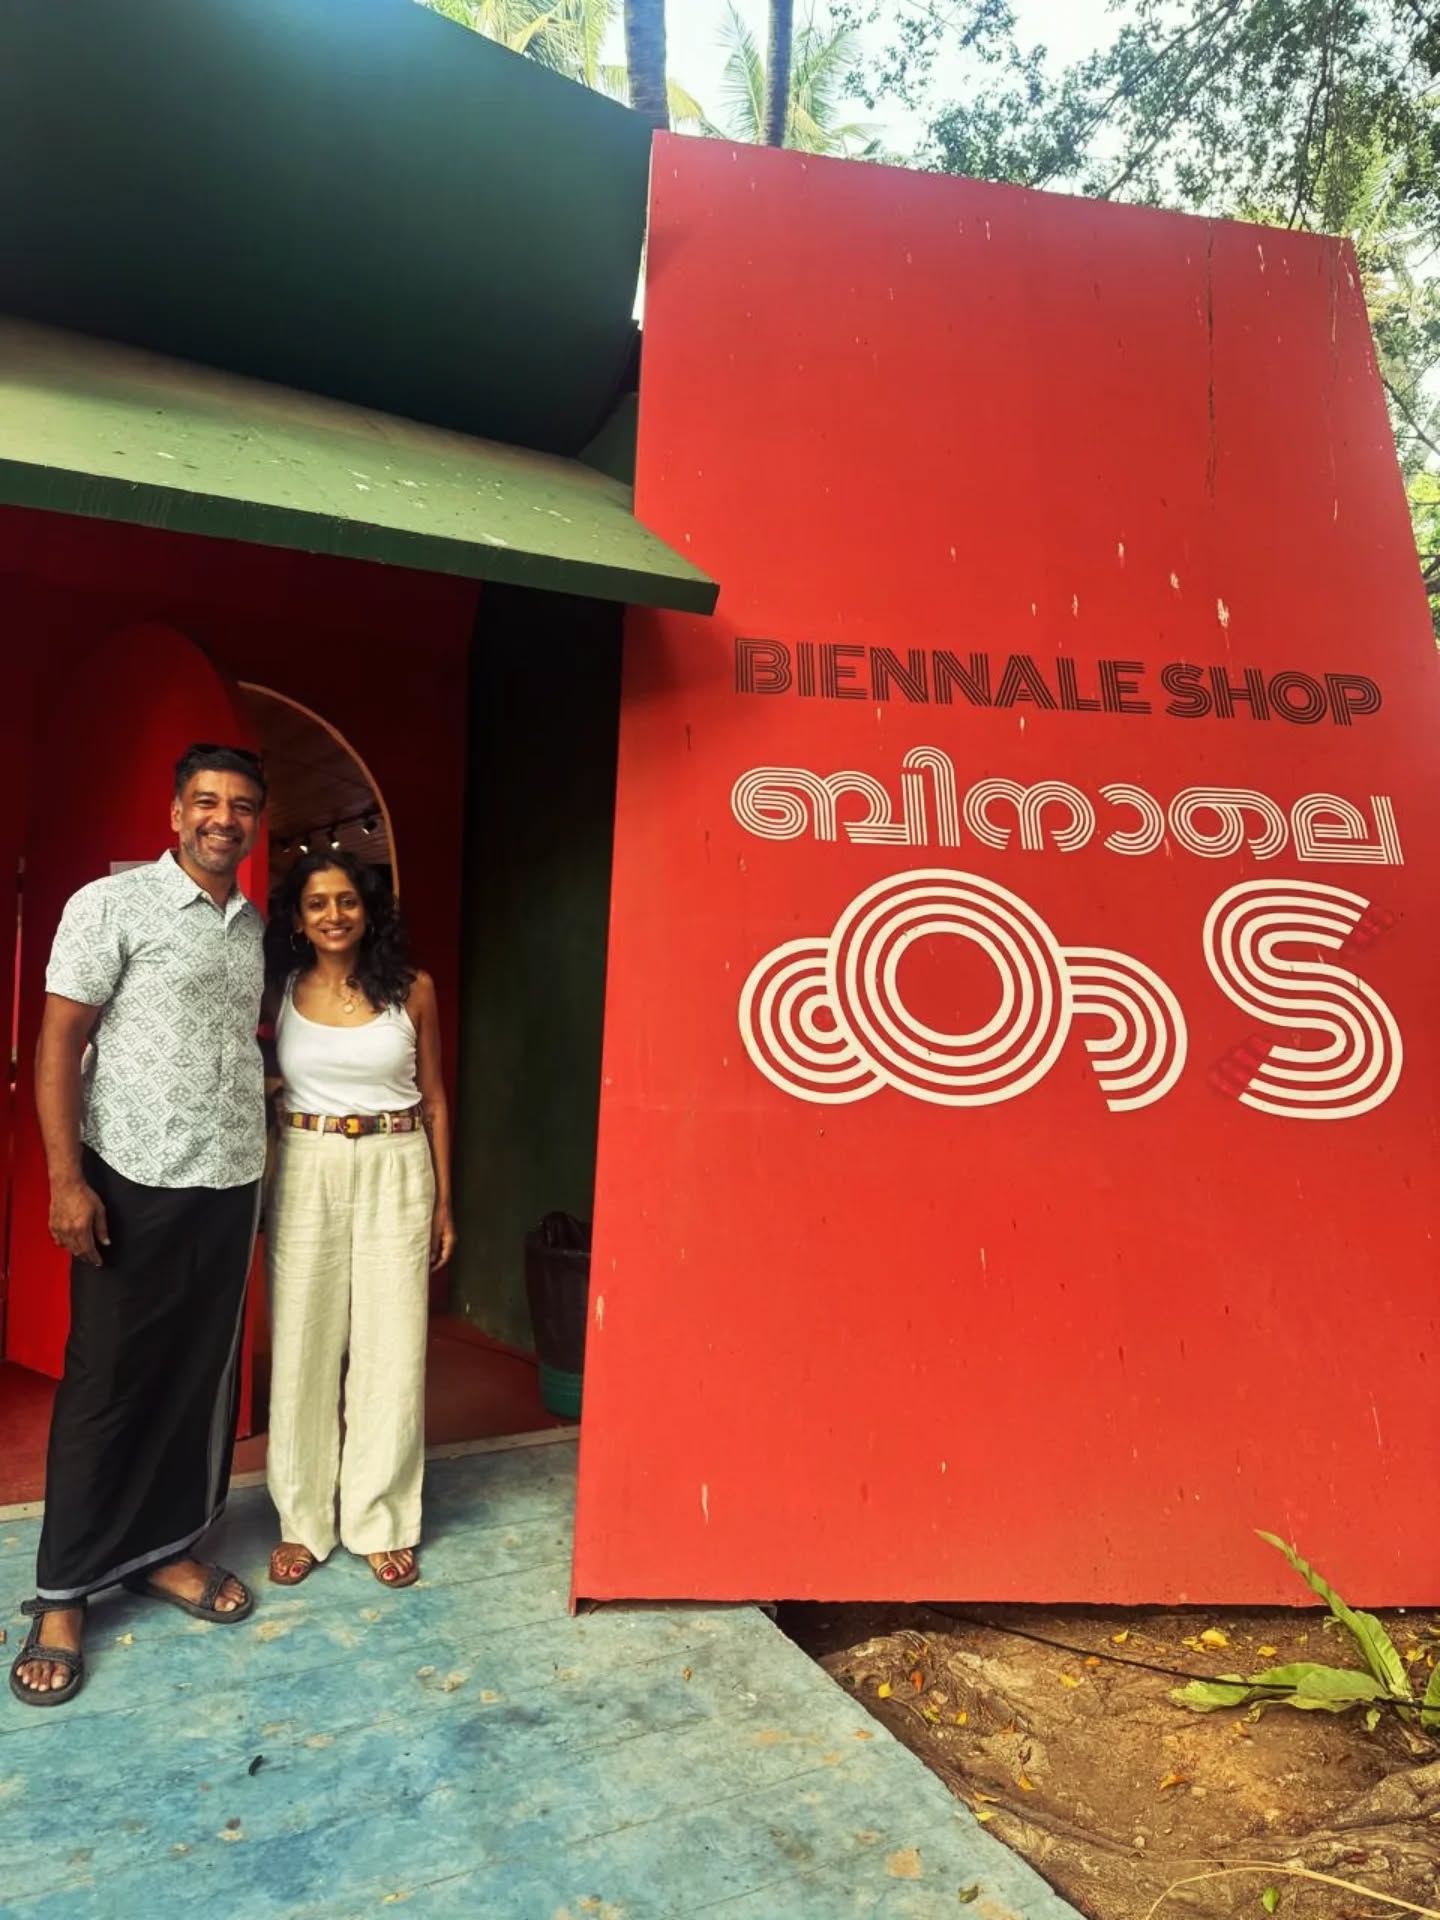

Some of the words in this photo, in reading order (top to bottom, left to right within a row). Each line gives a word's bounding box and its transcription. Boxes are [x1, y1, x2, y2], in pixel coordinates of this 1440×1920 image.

[735, 637, 1152, 714] BIENNALE
[1160, 662, 1383, 727] SHOP
[731, 746, 1404, 865] ബിനാലെ
